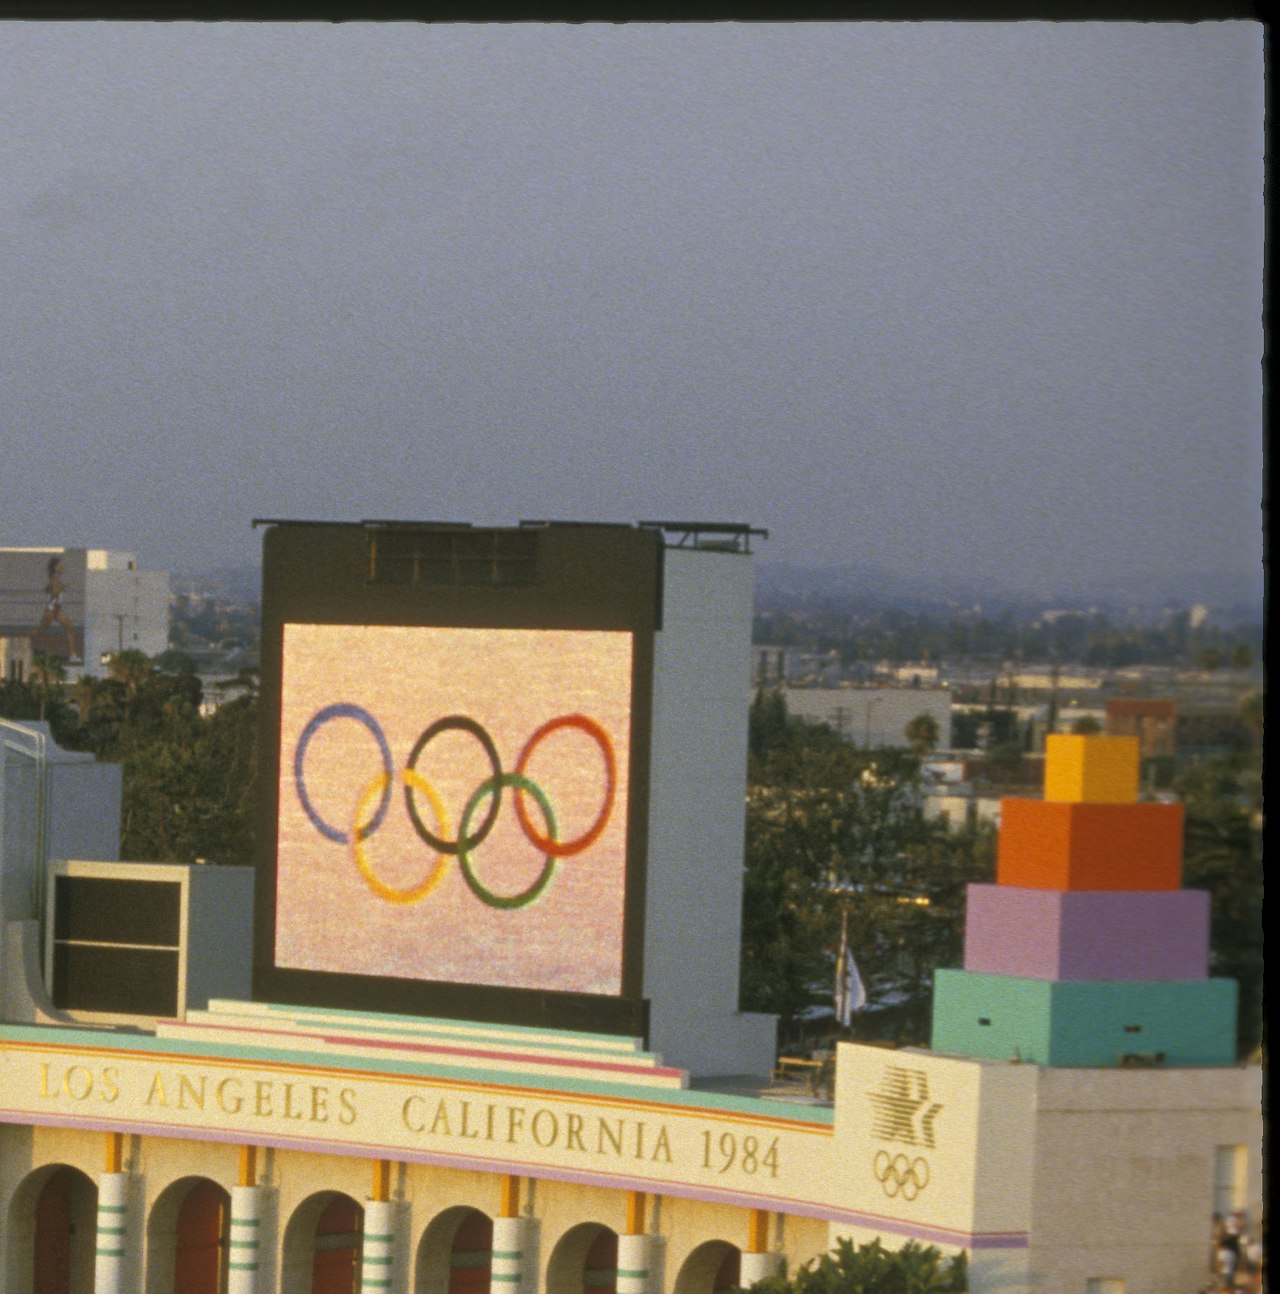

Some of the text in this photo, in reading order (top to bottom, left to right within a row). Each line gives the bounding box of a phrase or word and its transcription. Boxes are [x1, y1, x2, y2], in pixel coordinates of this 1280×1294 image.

[39, 1061, 781, 1179] LOS ANGELES CALIFORNIA 1984
